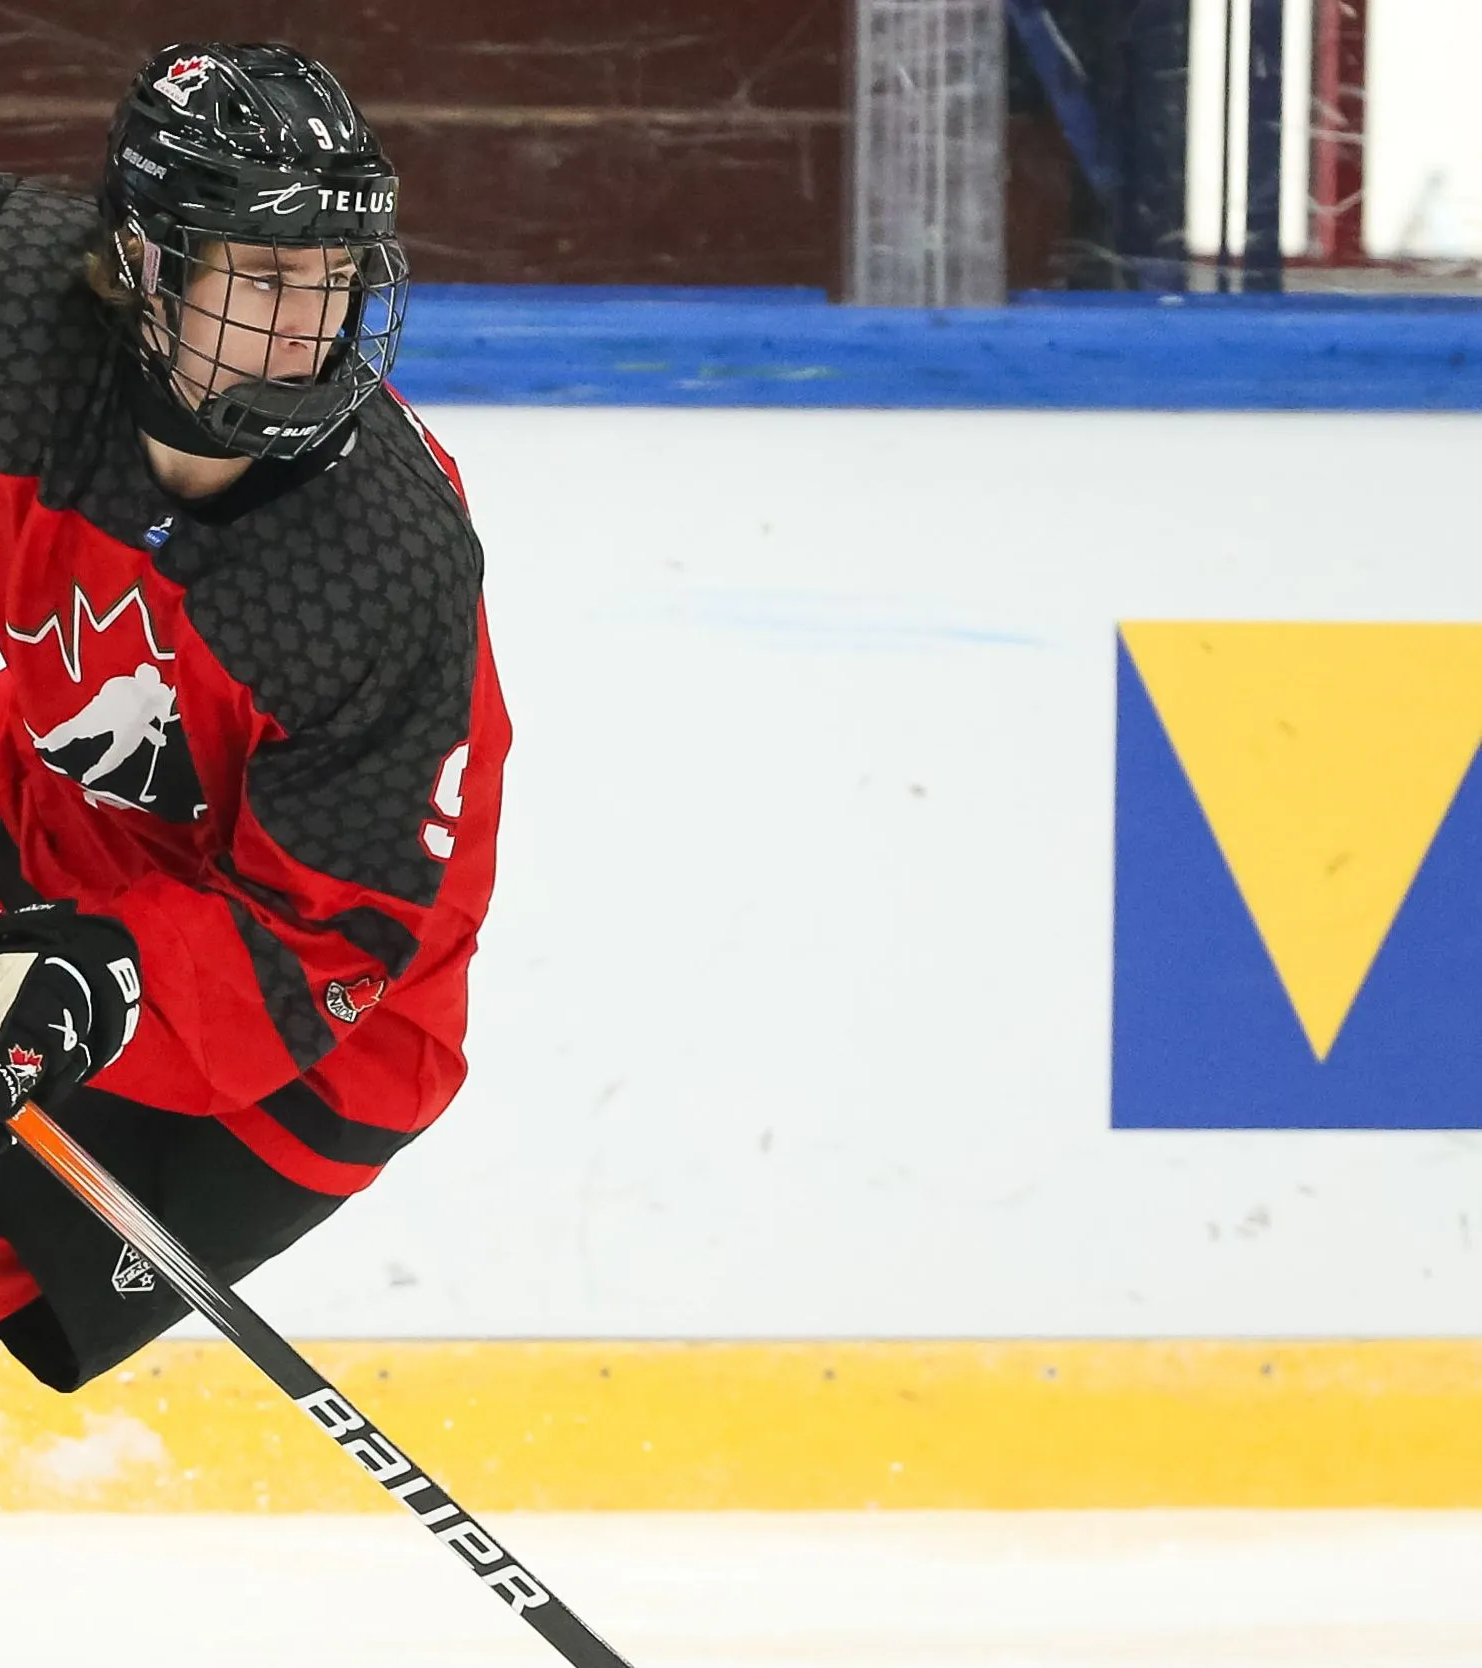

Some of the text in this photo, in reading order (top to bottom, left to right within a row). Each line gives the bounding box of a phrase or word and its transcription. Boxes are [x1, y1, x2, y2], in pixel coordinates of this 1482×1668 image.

[308, 117, 333, 150] 9
[318, 189, 394, 213] TELUS
[293, 1387, 550, 1616] BAUER
